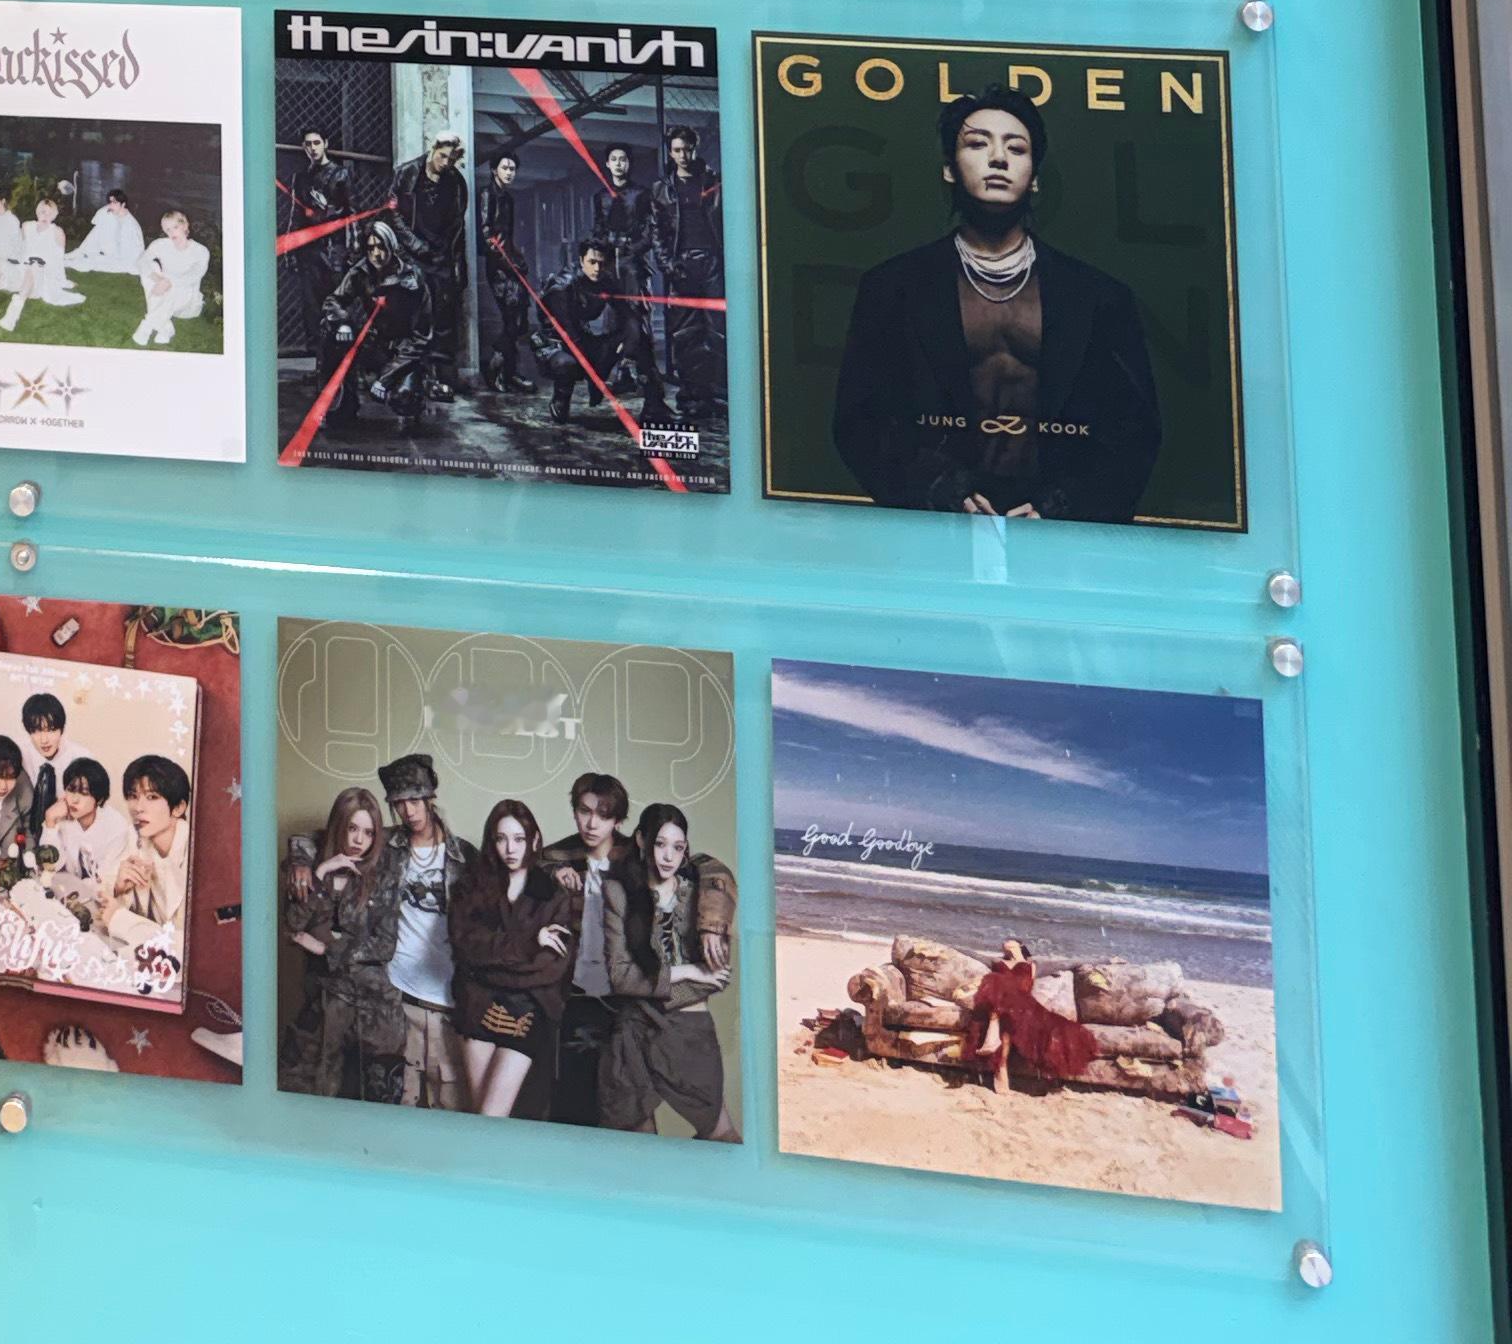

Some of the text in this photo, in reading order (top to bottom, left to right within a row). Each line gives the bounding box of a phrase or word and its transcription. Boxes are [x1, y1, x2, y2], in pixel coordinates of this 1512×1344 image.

[777, 53, 1204, 114] GOLDEN
[916, 413, 1090, 436] JUNG KOOK
[801, 822, 935, 870] Good Goodbye
